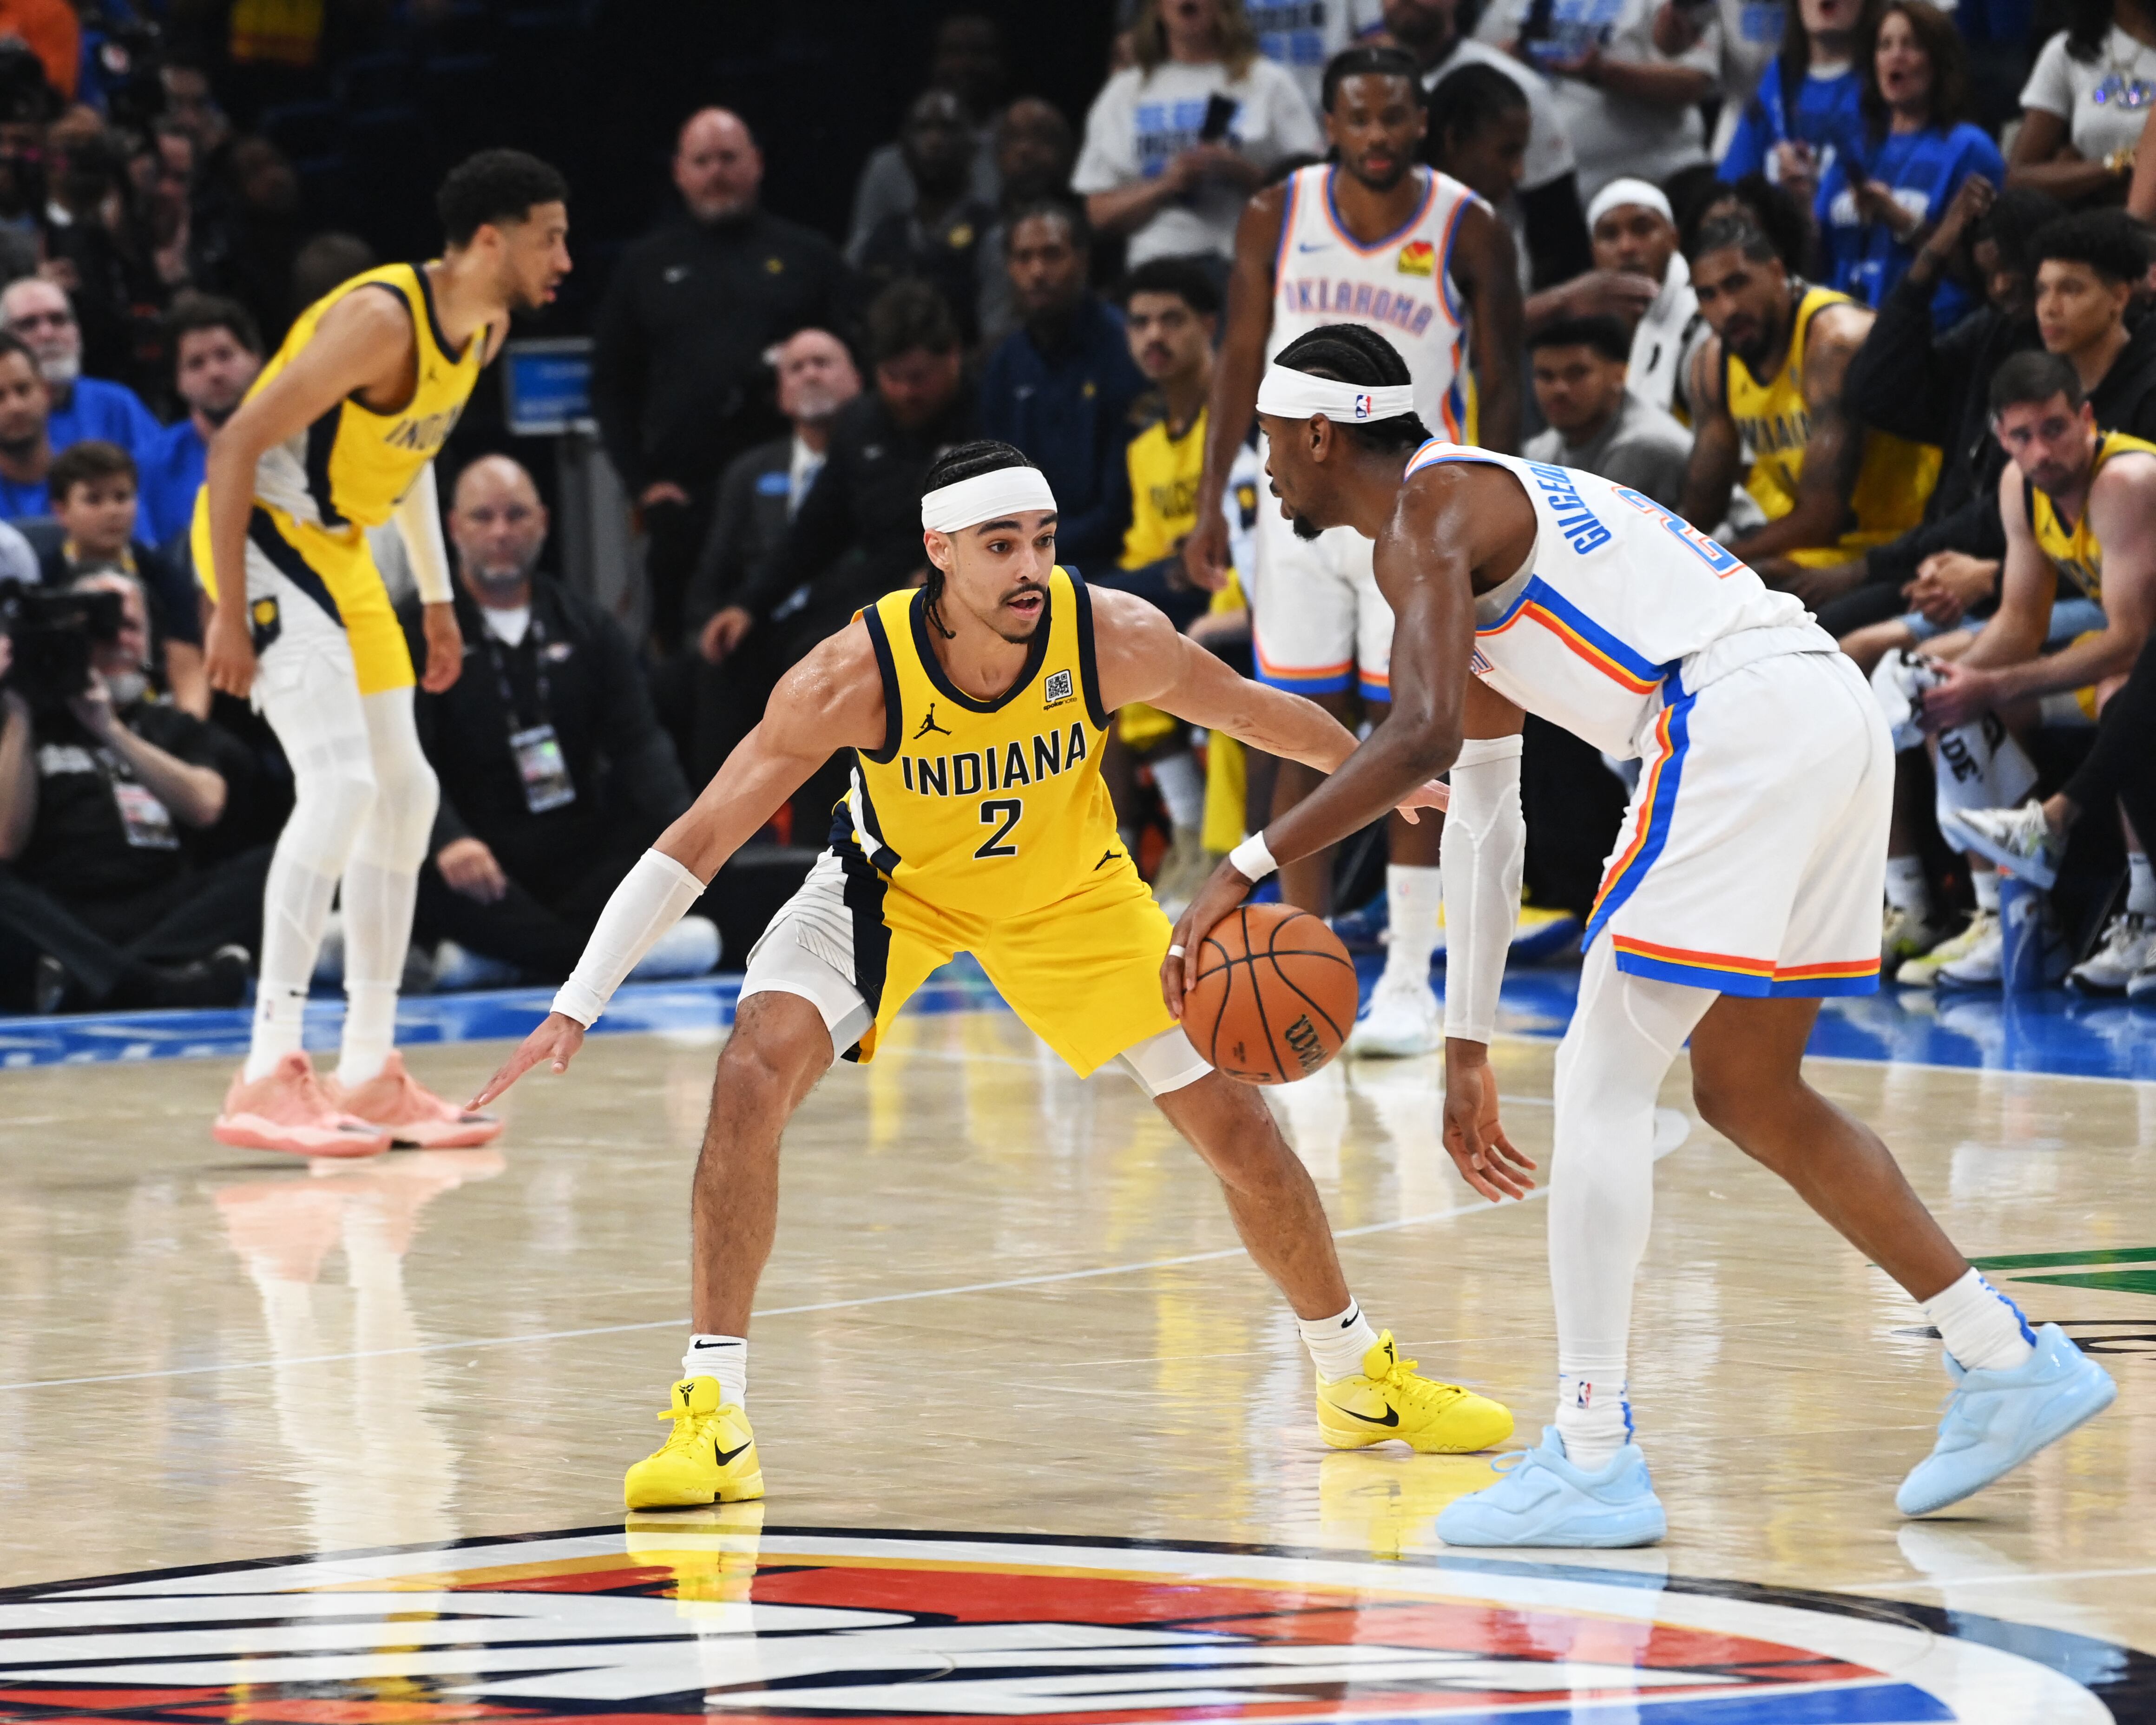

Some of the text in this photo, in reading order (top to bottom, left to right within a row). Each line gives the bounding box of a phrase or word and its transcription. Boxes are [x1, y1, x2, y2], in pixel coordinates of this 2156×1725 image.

[1043, 697, 1077, 711] spokenote
[901, 720, 1086, 797] INDIANA
[973, 797, 1024, 861] 2
